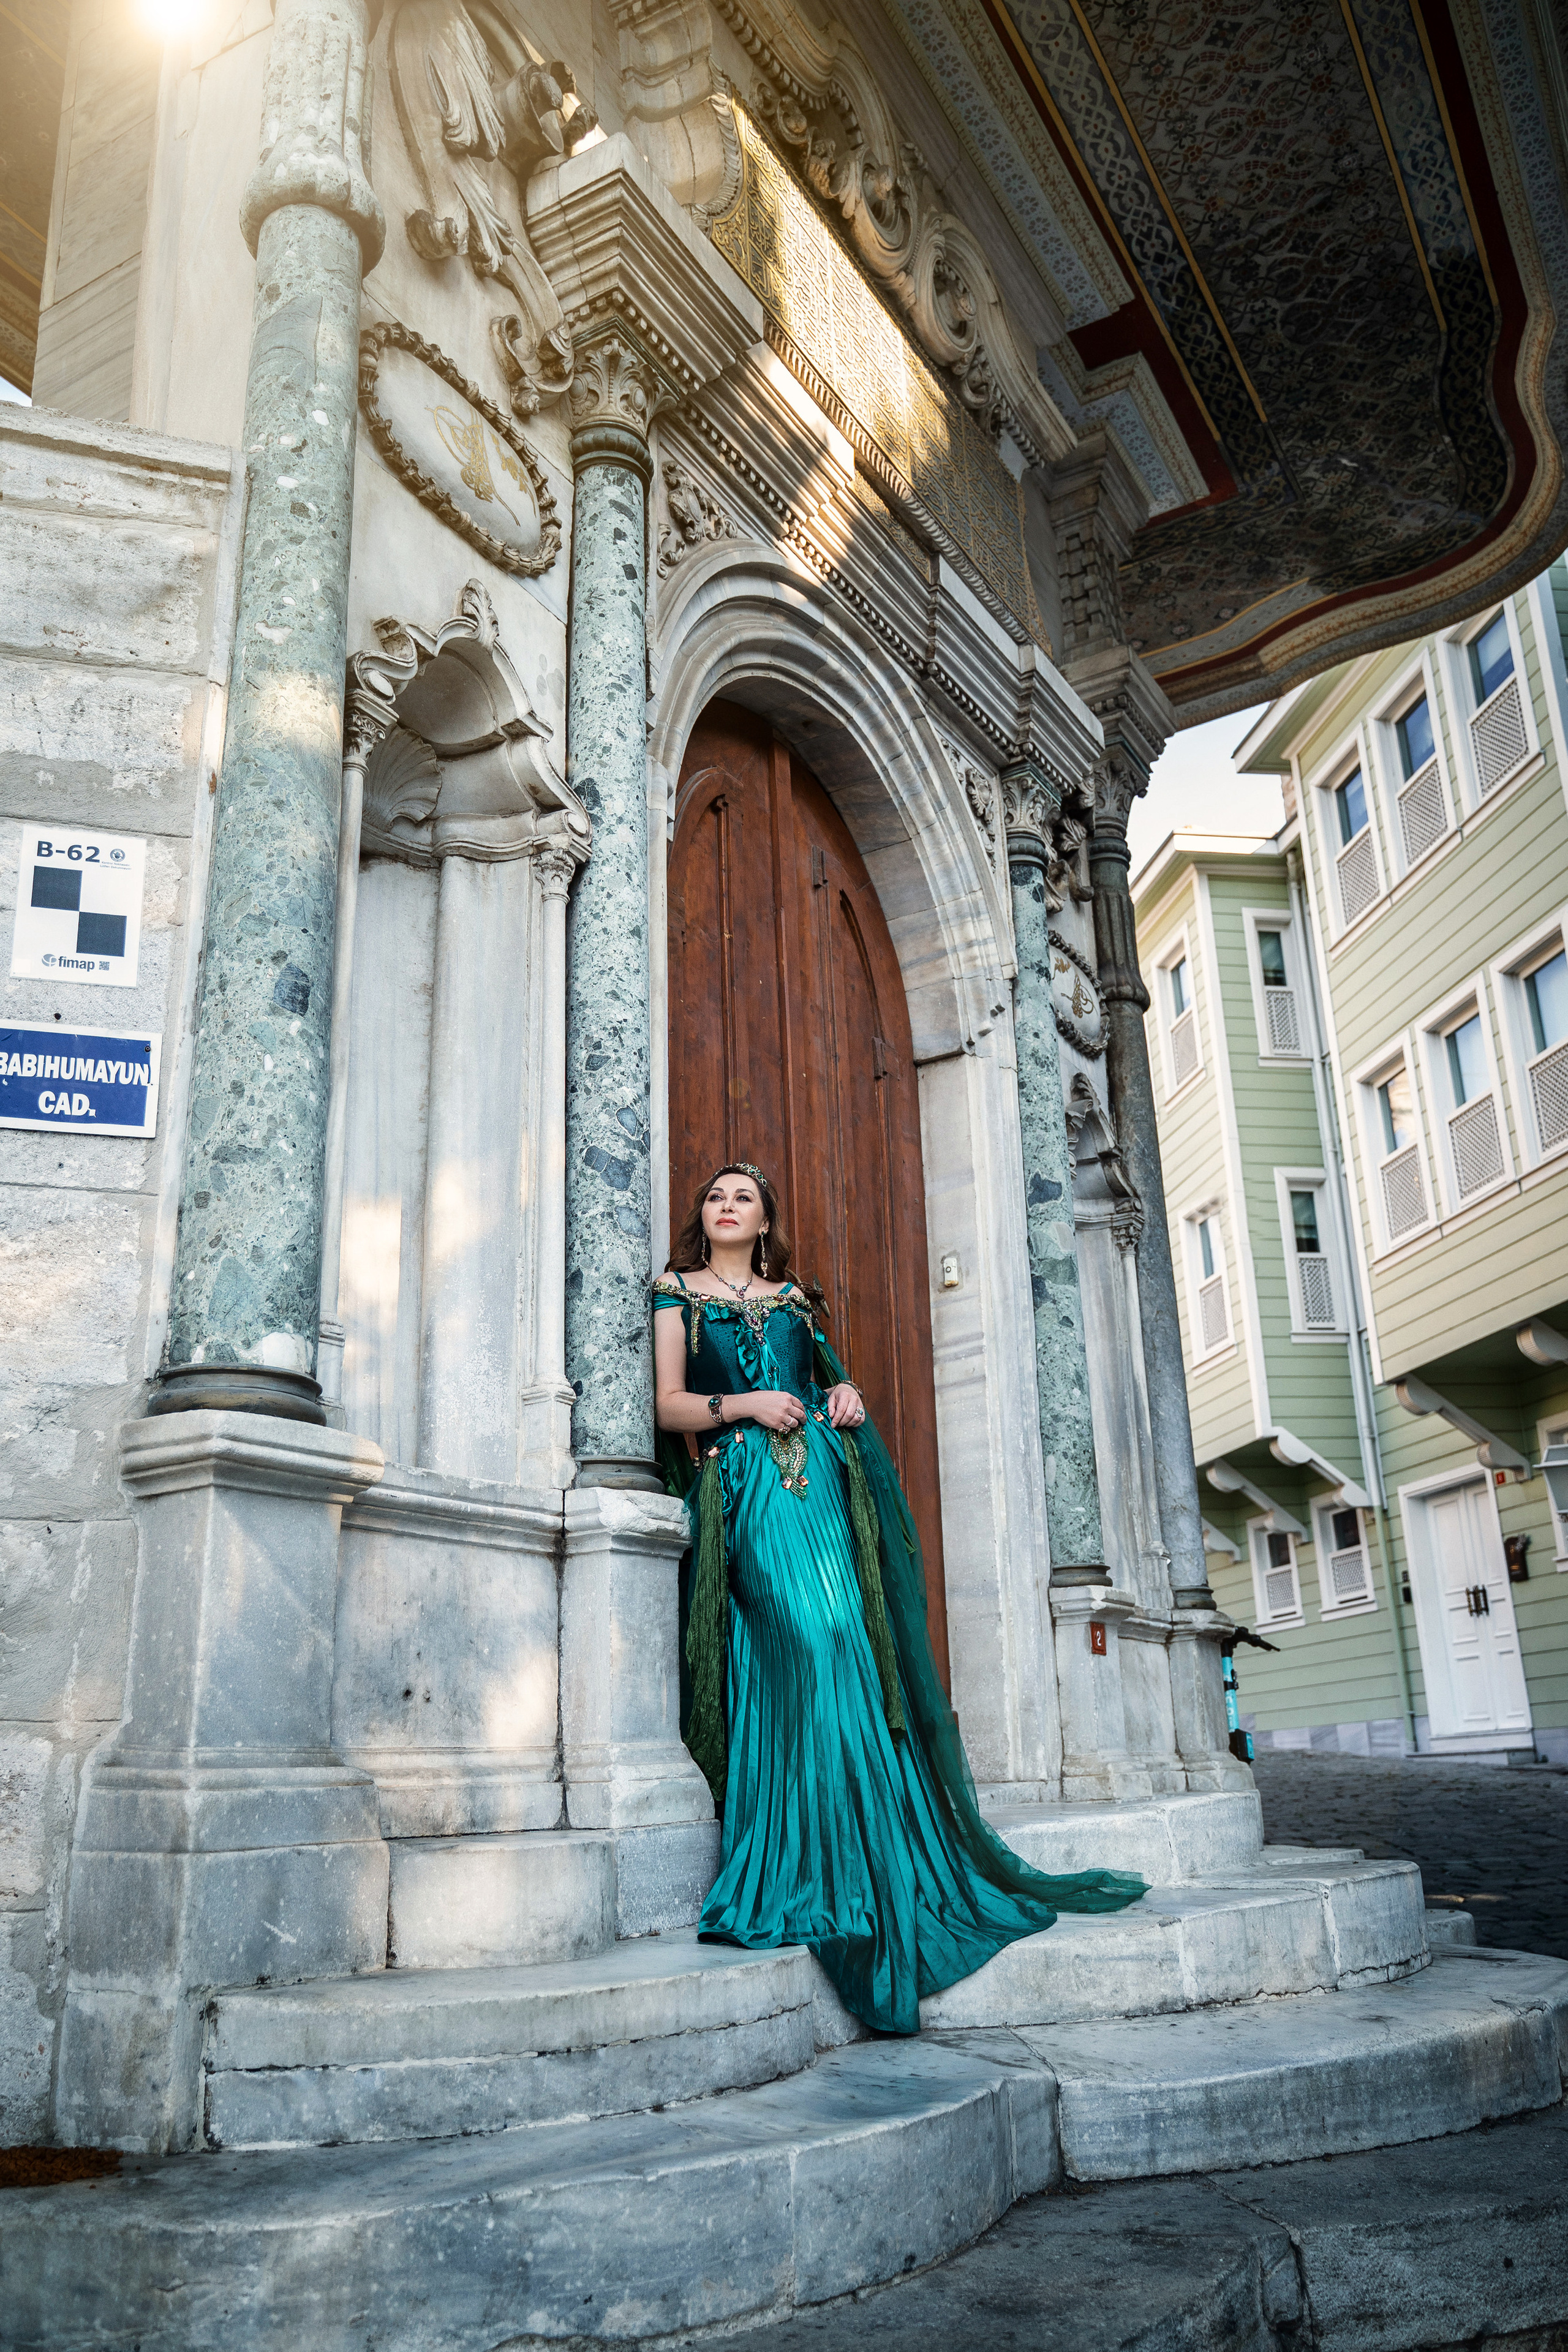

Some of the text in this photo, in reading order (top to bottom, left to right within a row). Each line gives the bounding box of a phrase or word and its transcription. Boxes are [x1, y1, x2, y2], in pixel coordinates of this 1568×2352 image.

[37, 840, 100, 863] B-62
[58, 956, 95, 972] fimap
[39, 1091, 96, 1117] CAD.
[1096, 1630, 1101, 1646] 2
